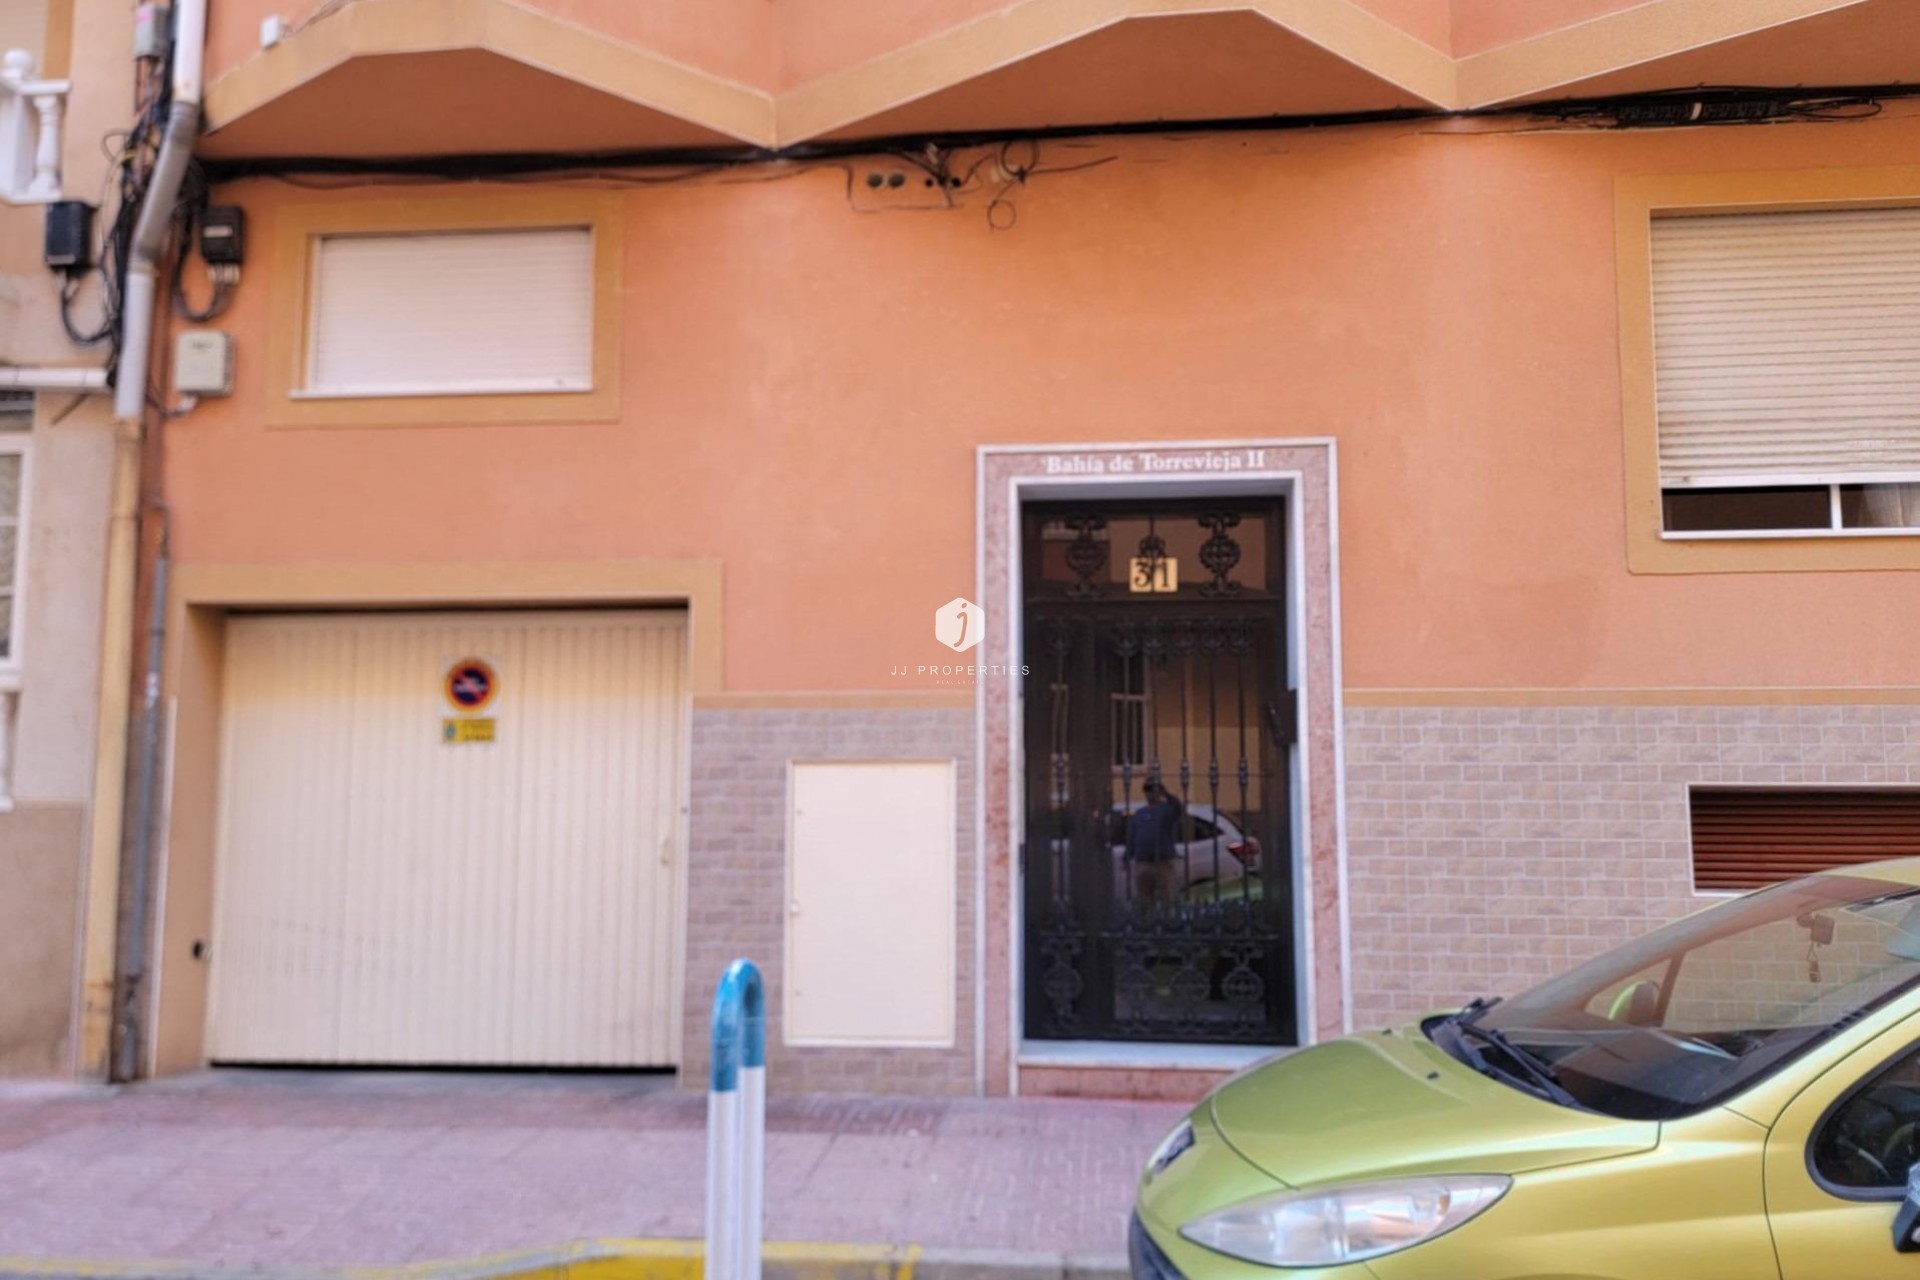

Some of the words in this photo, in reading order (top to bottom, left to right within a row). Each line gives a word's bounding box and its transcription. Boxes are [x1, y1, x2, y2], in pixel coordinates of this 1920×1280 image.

[1046, 454, 1104, 473] Bahía
[1109, 454, 1134, 472] de
[1140, 452, 1242, 472] Torrevieja
[1247, 450, 1265, 468] II
[1134, 561, 1170, 588] 31
